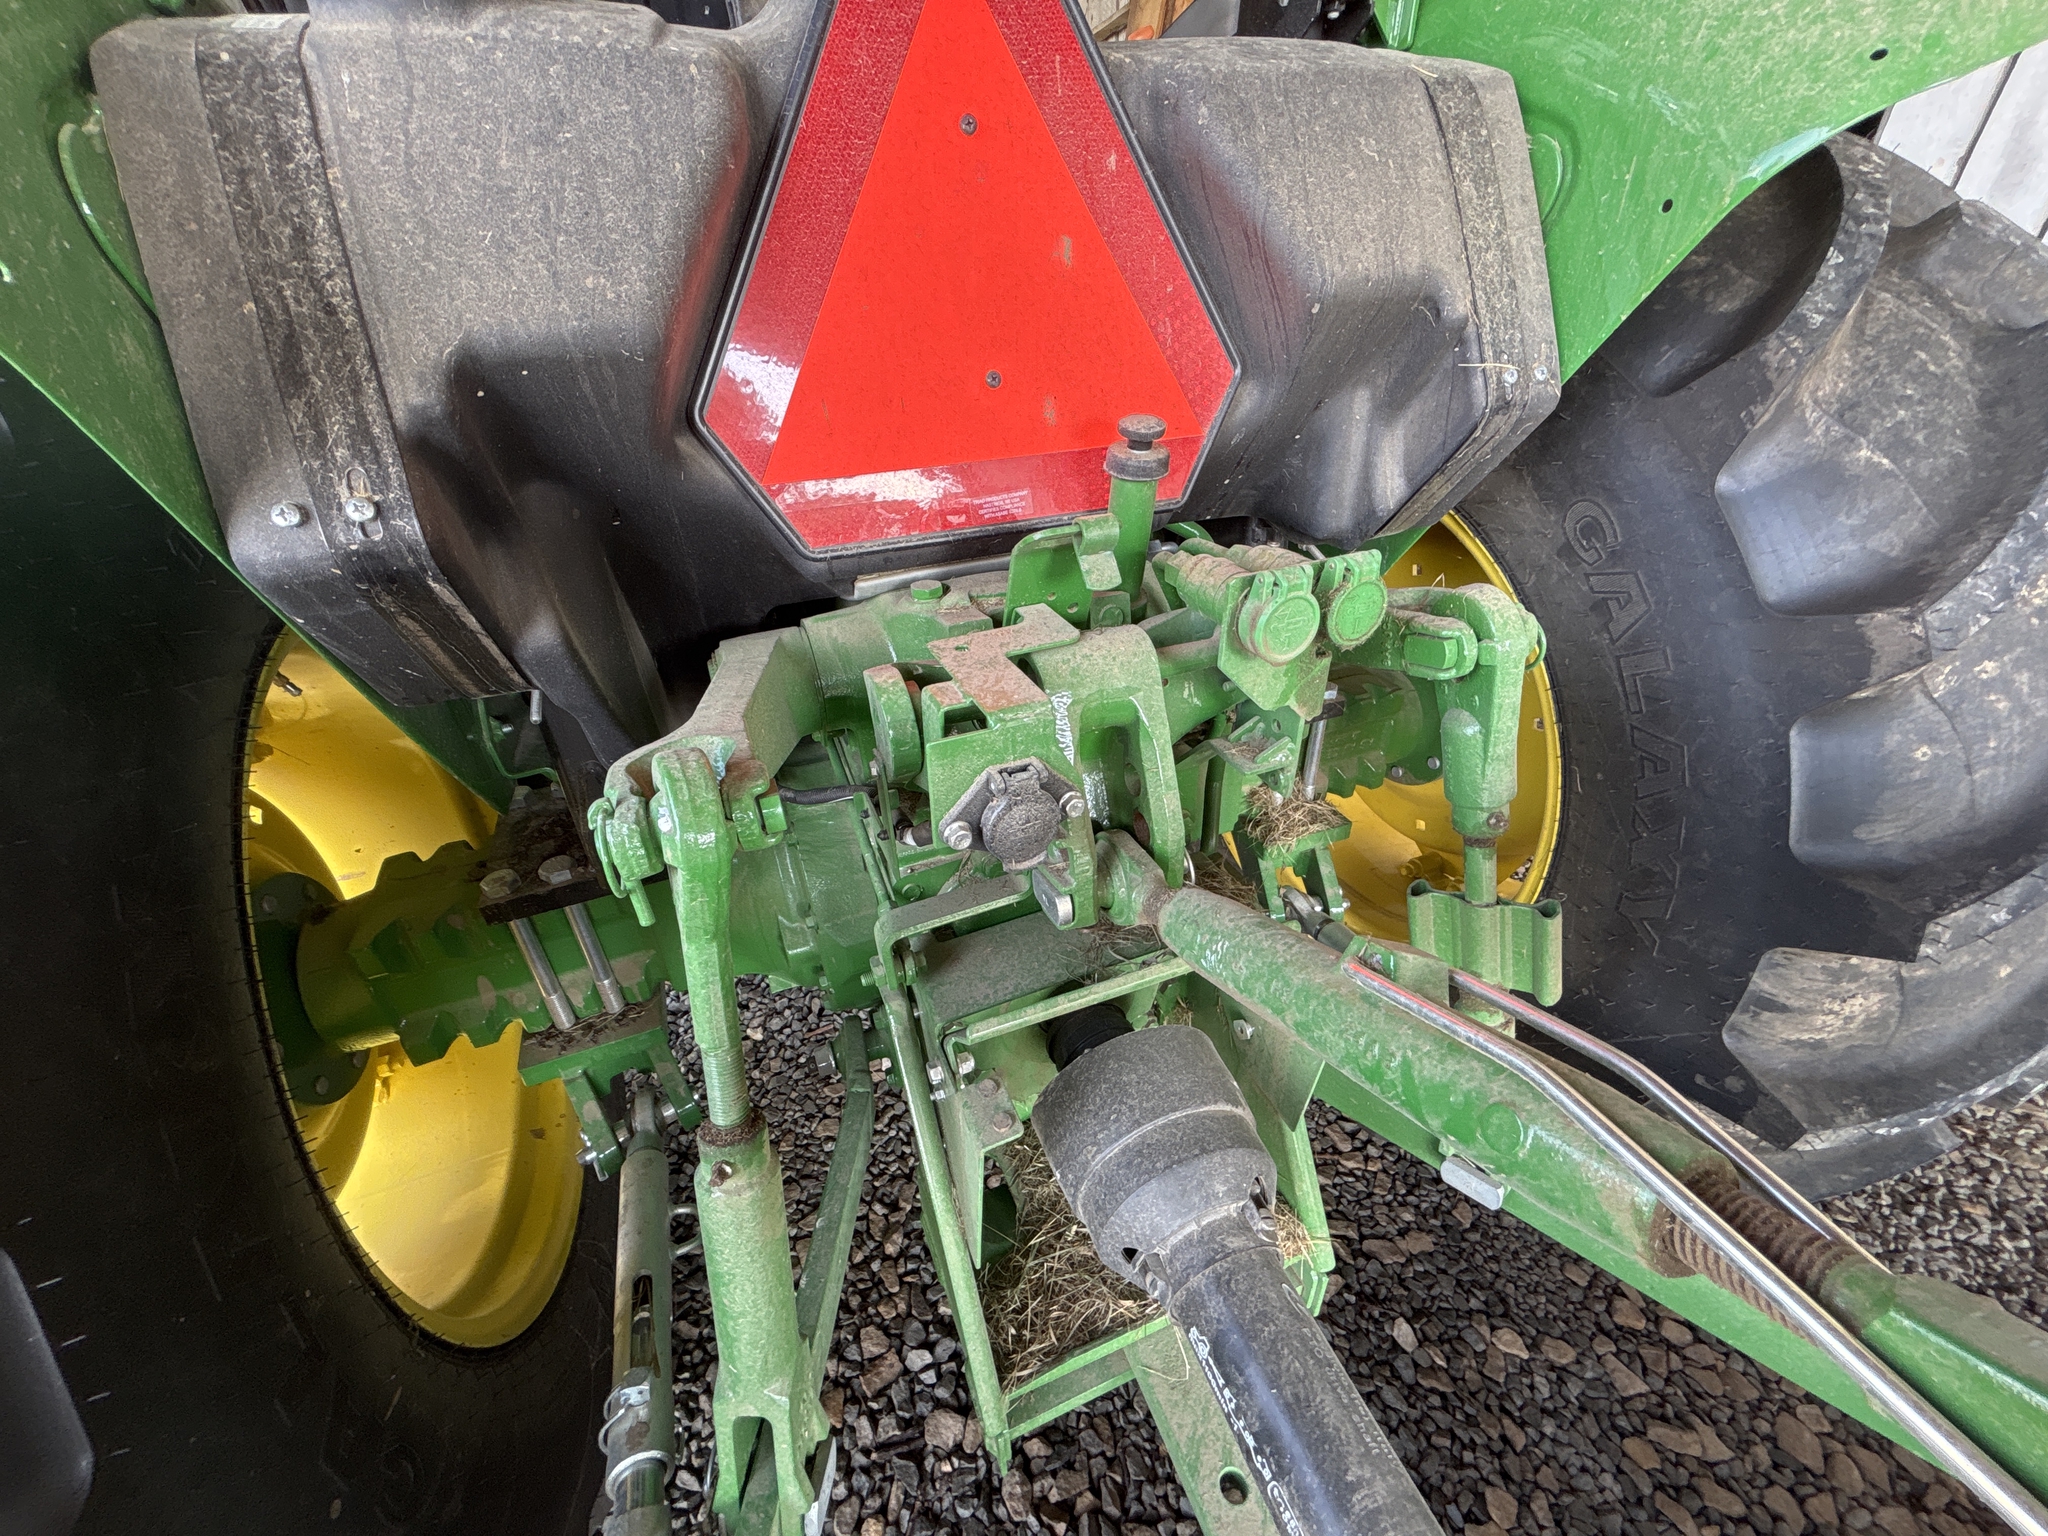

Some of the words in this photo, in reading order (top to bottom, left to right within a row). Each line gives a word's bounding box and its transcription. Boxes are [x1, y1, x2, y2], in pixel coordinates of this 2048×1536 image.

[985, 494, 1008, 502] PRODUCTS
[1008, 490, 1028, 498] COMPANY
[1000, 501, 1026, 510] COMPLIANCE
[1563, 498, 1688, 957] GALAXY
[1302, 1327, 1325, 1359] PTO
[1351, 1414, 1381, 1456] shaft
